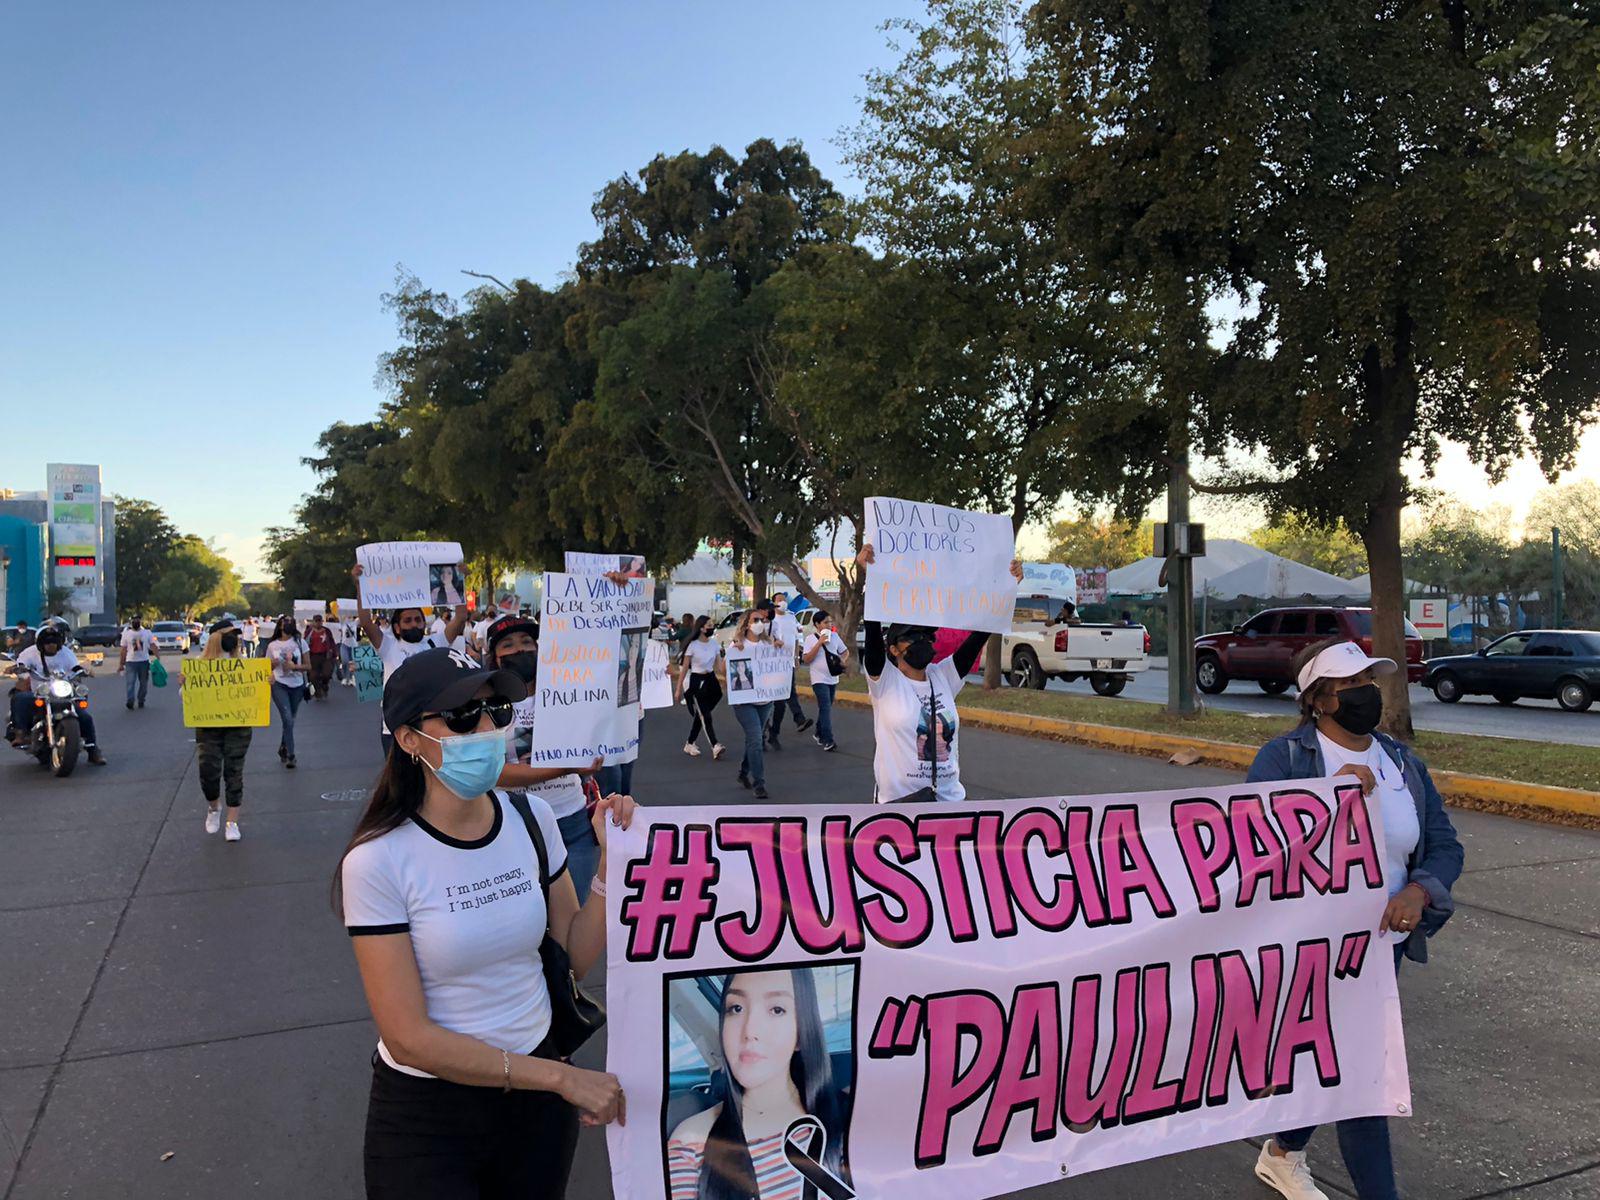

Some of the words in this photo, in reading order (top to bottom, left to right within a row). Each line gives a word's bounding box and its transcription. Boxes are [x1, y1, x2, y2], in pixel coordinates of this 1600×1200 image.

[873, 500, 905, 528] NO
[909, 505, 925, 528] A
[932, 507, 975, 533] LOS
[879, 529, 975, 553] DOCTORES
[1423, 603, 1433, 618] E
[183, 659, 245, 675] JUSTICIA
[542, 689, 610, 708] PAULINA
[472, 878, 492, 891] not
[493, 867, 525, 885] crazy,
[620, 804, 1177, 963] #JUSTICIA
[1170, 784, 1384, 913] PARA
[474, 892, 499, 909] just
[499, 880, 532, 899] happy
